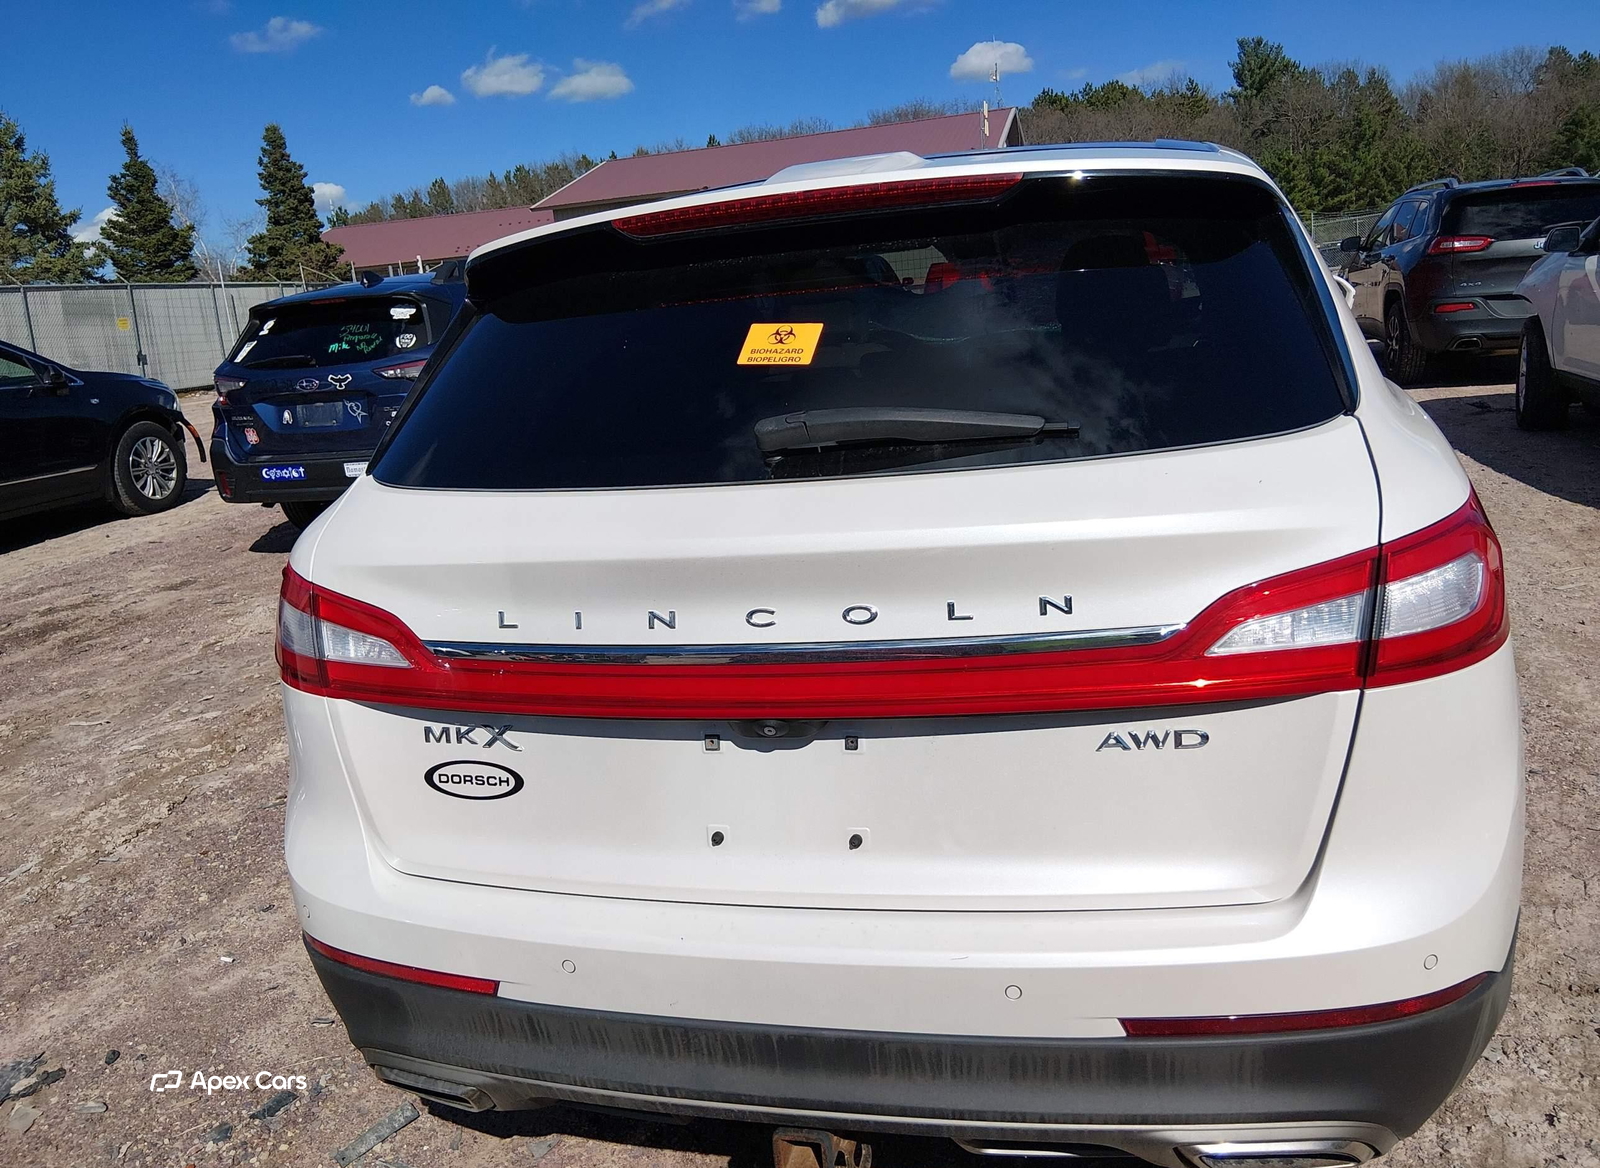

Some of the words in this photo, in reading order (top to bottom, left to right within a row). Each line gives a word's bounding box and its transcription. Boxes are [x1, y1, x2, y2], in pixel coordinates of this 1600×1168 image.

[328, 341, 351, 353] Mike
[497, 594, 1073, 630] LINCOLN
[423, 724, 524, 752] MKX
[1095, 728, 1210, 752] AWD
[438, 773, 510, 787] DORSCH
